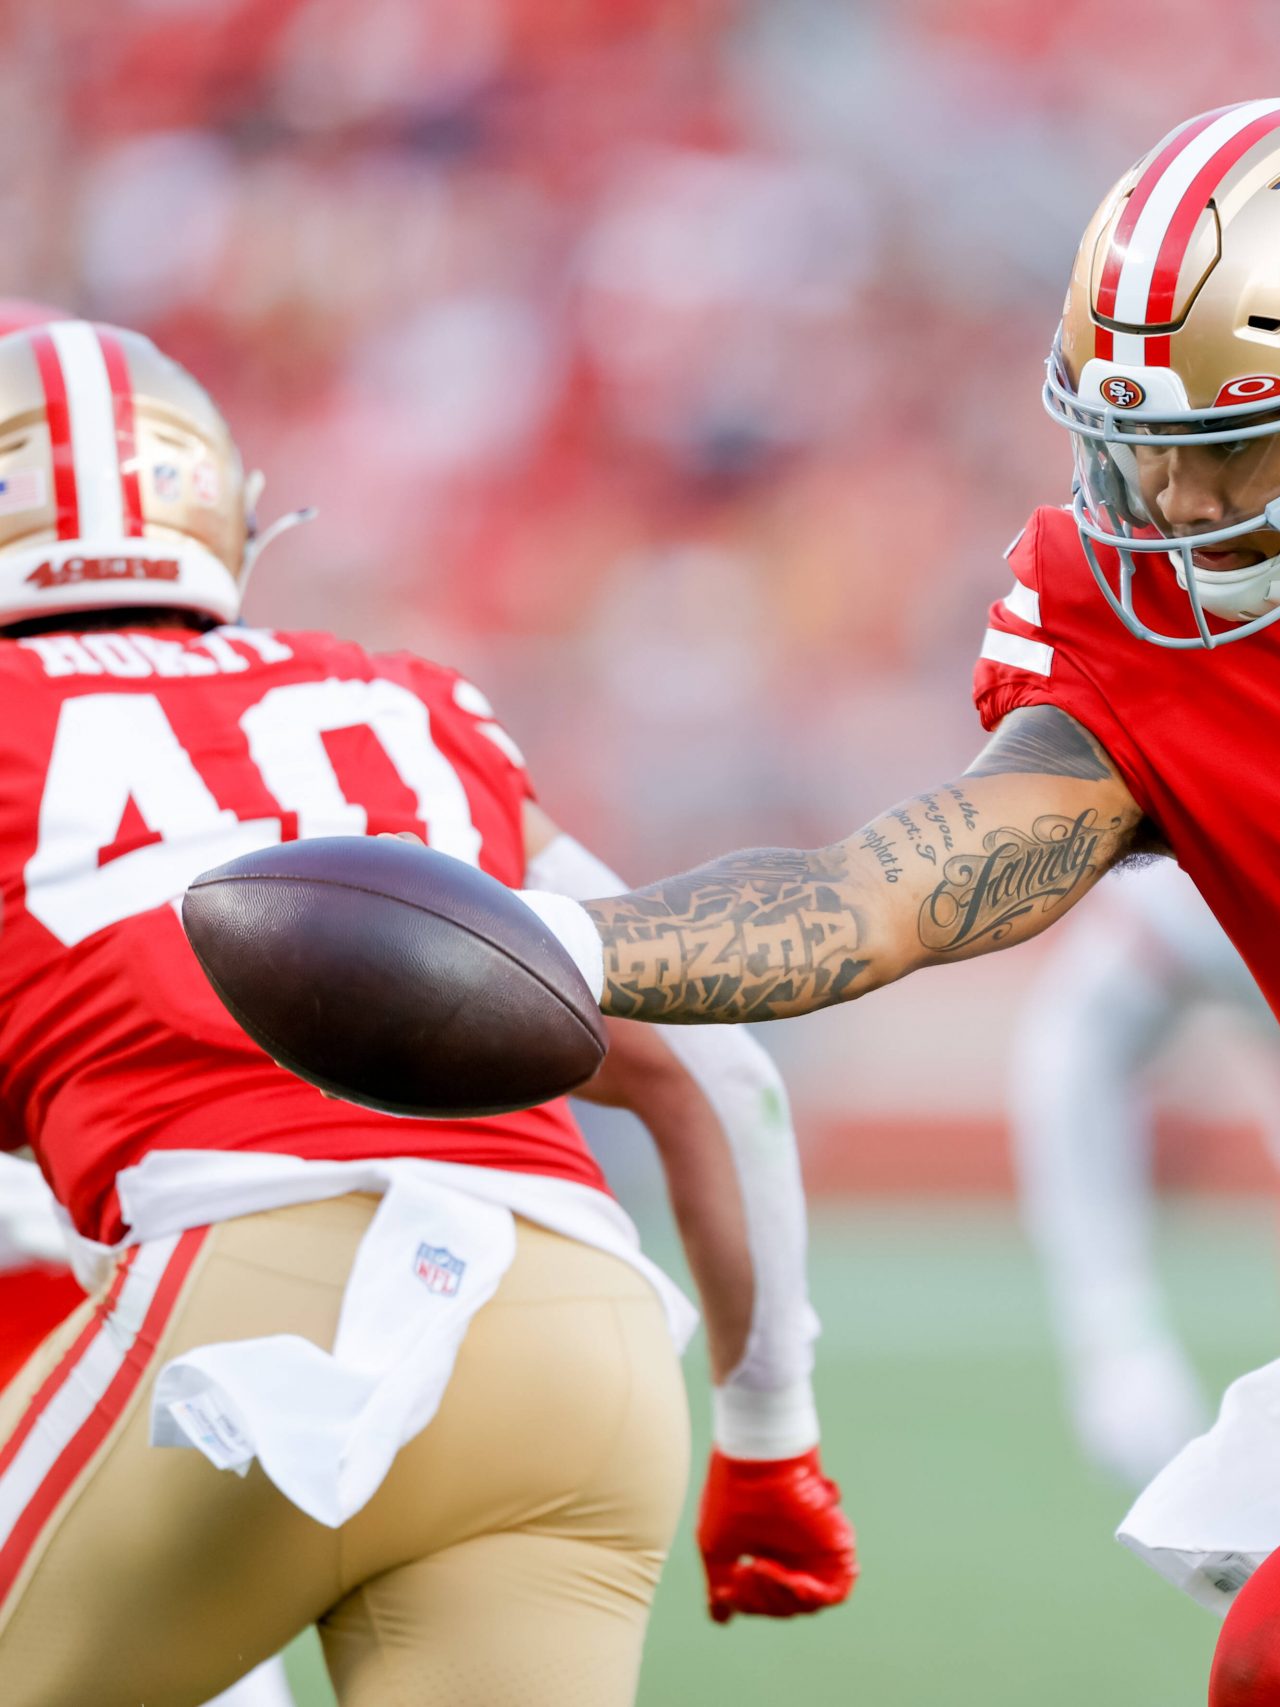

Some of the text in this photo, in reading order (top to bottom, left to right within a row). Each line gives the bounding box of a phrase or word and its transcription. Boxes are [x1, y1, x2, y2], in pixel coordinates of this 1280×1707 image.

[22, 676, 484, 948] 40
[925, 811, 954, 851] you
[958, 801, 980, 831] the
[859, 827, 904, 884] rophet to
[918, 808, 1122, 952] Family
